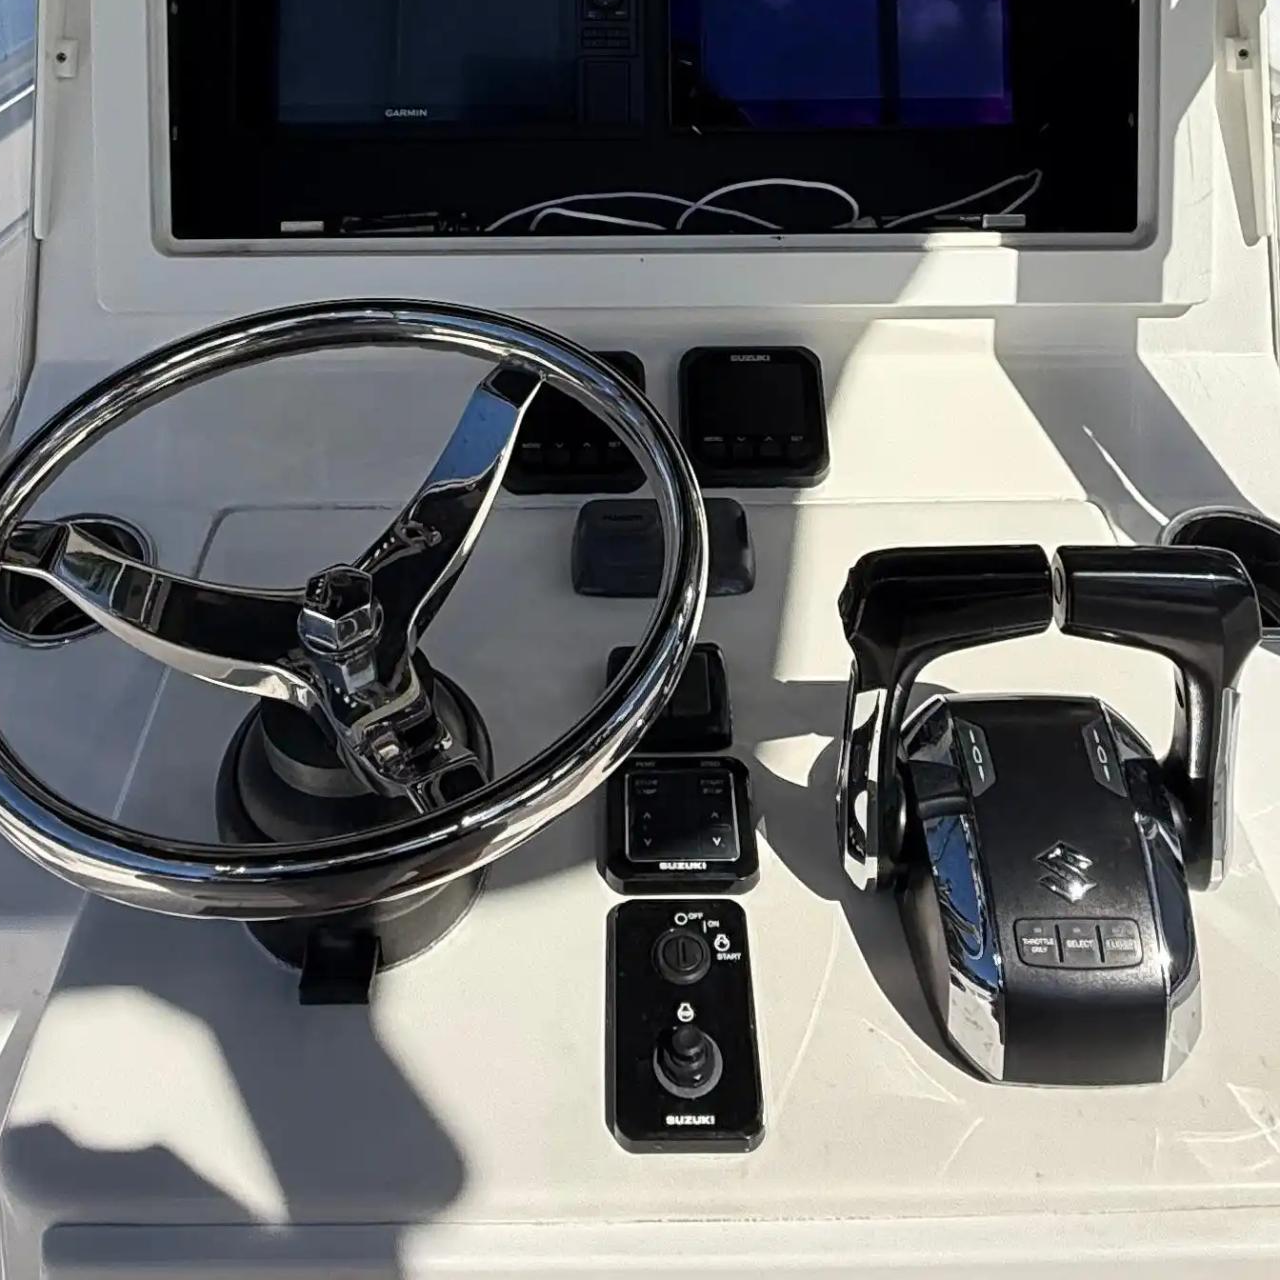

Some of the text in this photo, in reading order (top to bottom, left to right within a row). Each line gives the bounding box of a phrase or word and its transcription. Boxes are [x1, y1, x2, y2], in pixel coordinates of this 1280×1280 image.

[384, 108, 428, 118] GARMIN
[730, 354, 771, 362] SUZUKI
[659, 861, 707, 870] SUZUKI
[688, 912, 704, 920] OFF
[707, 920, 720, 928] ON
[1066, 939, 1094, 949] SELECT
[716, 952, 742, 961] START
[666, 1115, 716, 1126] SUZUKI
